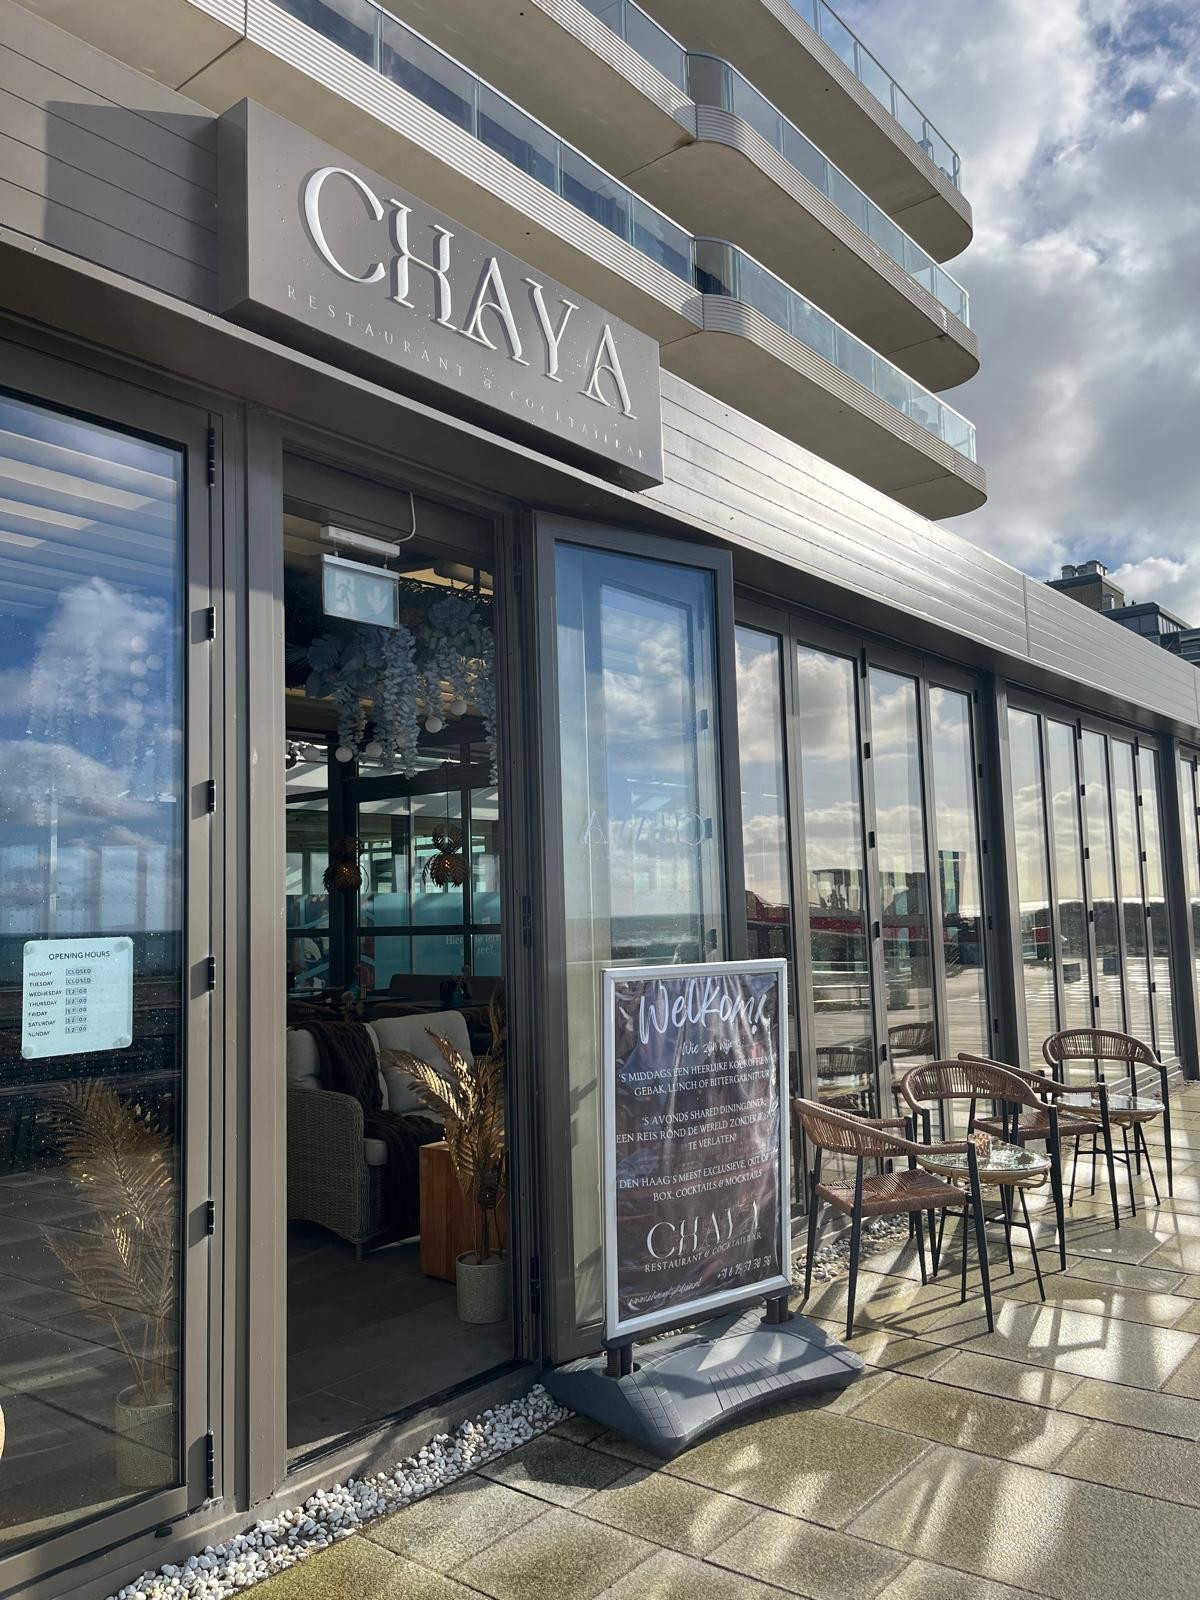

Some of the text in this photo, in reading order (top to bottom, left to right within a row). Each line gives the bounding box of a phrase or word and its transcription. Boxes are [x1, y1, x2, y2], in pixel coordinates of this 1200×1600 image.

[304, 166, 637, 420] CHAYA
[288, 285, 464, 376] RESTAURANT
[48, 950, 111, 961] OPENING HOURS
[28, 968, 92, 978] MONDAY CLOSED
[67, 977, 92, 985] CLOSED
[28, 990, 62, 998] WEDNESDAY
[29, 1000, 57, 1008] THURSDAY
[28, 1010, 48, 1018] FRIDAY
[28, 1020, 56, 1028] SATURDAY
[28, 1030, 51, 1038] SUNDAY
[628, 1068, 672, 1082] MIDDAGS
[673, 1066, 690, 1077] EEN
[691, 1061, 728, 1075] HEERLIJKE
[668, 1080, 698, 1093] LUNCH
[698, 1079, 710, 1089] OF
[710, 1069, 770, 1087] BITTERGARNITUUR
[651, 1111, 689, 1125] AVONDS
[690, 1106, 719, 1120] SHARED
[616, 1133, 634, 1144] EEN
[637, 1131, 658, 1142] REIS
[660, 1128, 687, 1140] ROND
[687, 1125, 699, 1136] DE
[699, 1120, 729, 1134] WERELD
[688, 1140, 698, 1151] TE
[619, 1178, 639, 1189] DEN
[641, 1174, 677, 1187] HAAG'S
[678, 1169, 702, 1182] MEEST
[747, 1155, 760, 1167] OUT
[675, 1181, 717, 1198] COCKTAILS
[725, 1169, 762, 1187] MOCKTAILS
[644, 1251, 702, 1273] RESTAURANT
[711, 1231, 762, 1256] COCKTAILBAR
